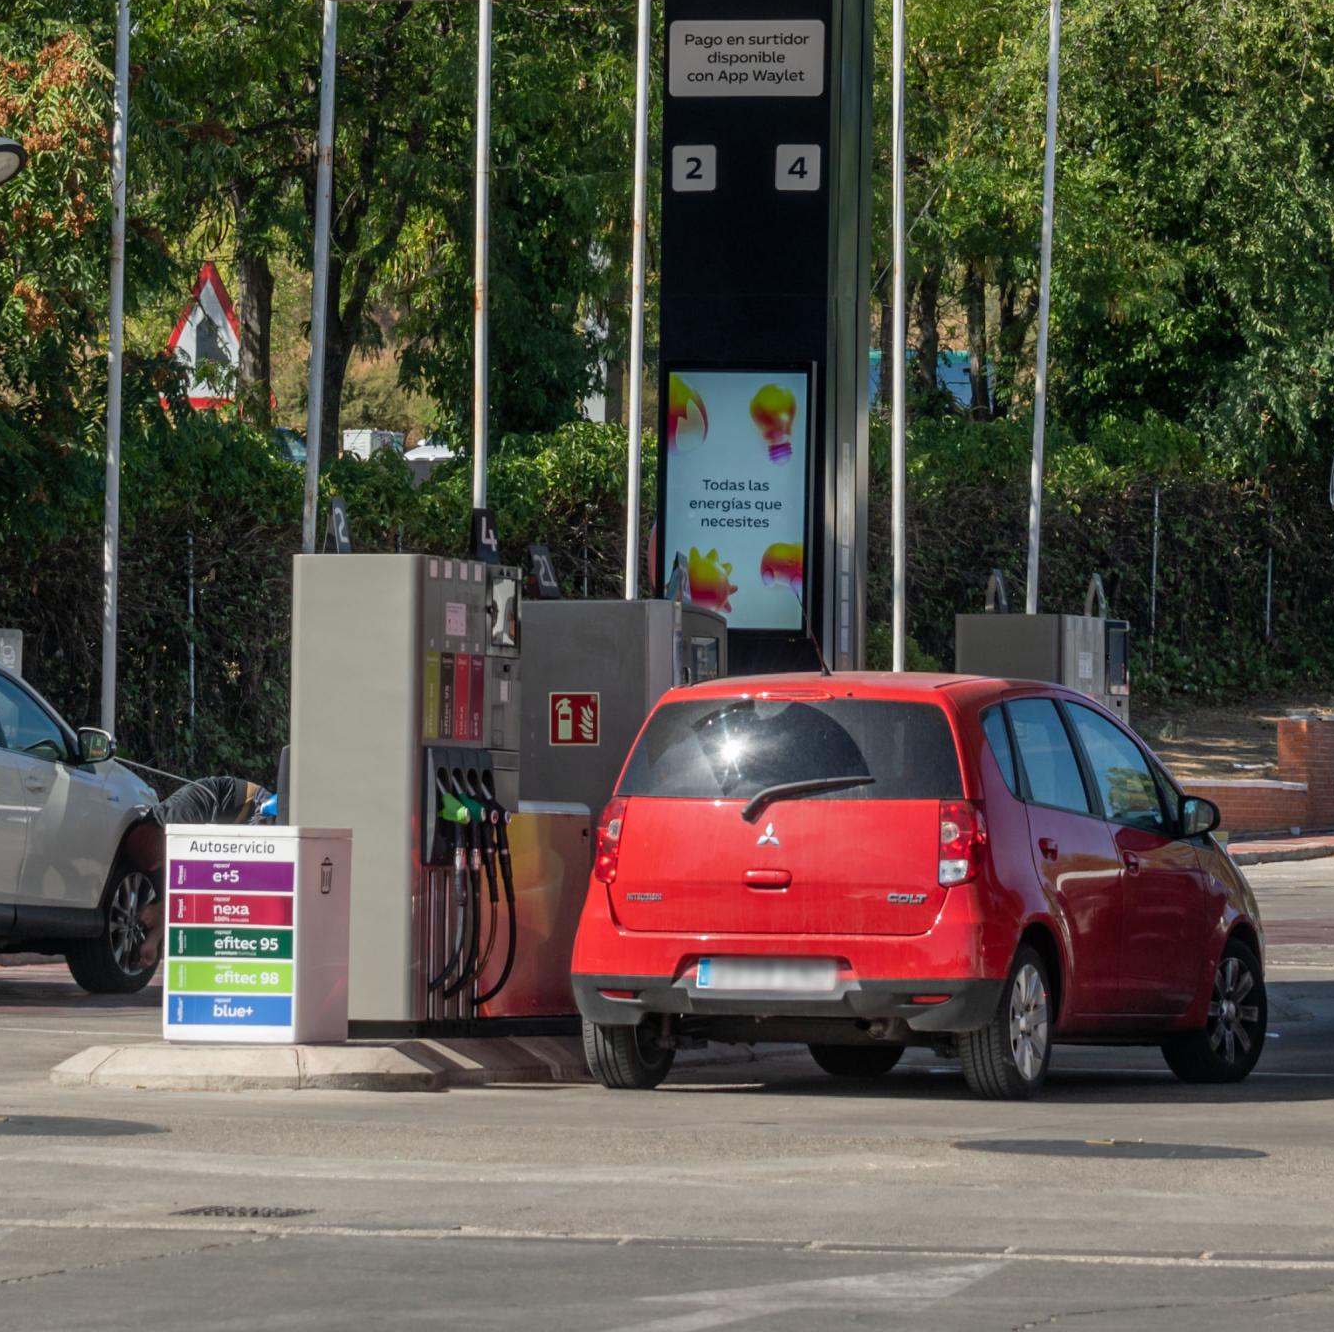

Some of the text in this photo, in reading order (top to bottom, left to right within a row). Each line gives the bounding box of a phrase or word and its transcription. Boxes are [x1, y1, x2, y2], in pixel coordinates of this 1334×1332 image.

[684, 33, 810, 48] Pago en surtidor
[707, 51, 786, 66] disponible
[687, 69, 805, 84] con App Waylet
[685, 156, 703, 180] 2
[787, 156, 808, 179] 4
[702, 479, 770, 492] Todas las
[689, 497, 783, 513] energías que
[333, 506, 349, 544] 2
[700, 516, 770, 528] necesites
[480, 514, 498, 552] 4
[189, 840, 276, 855] Autoservicio
[212, 870, 240, 884] e+5
[887, 892, 928, 905] COLT
[213, 903, 250, 916] nexa
[214, 937, 279, 952] efitec 95
[214, 971, 280, 985] efitec 98
[213, 1004, 254, 1018] blue+
